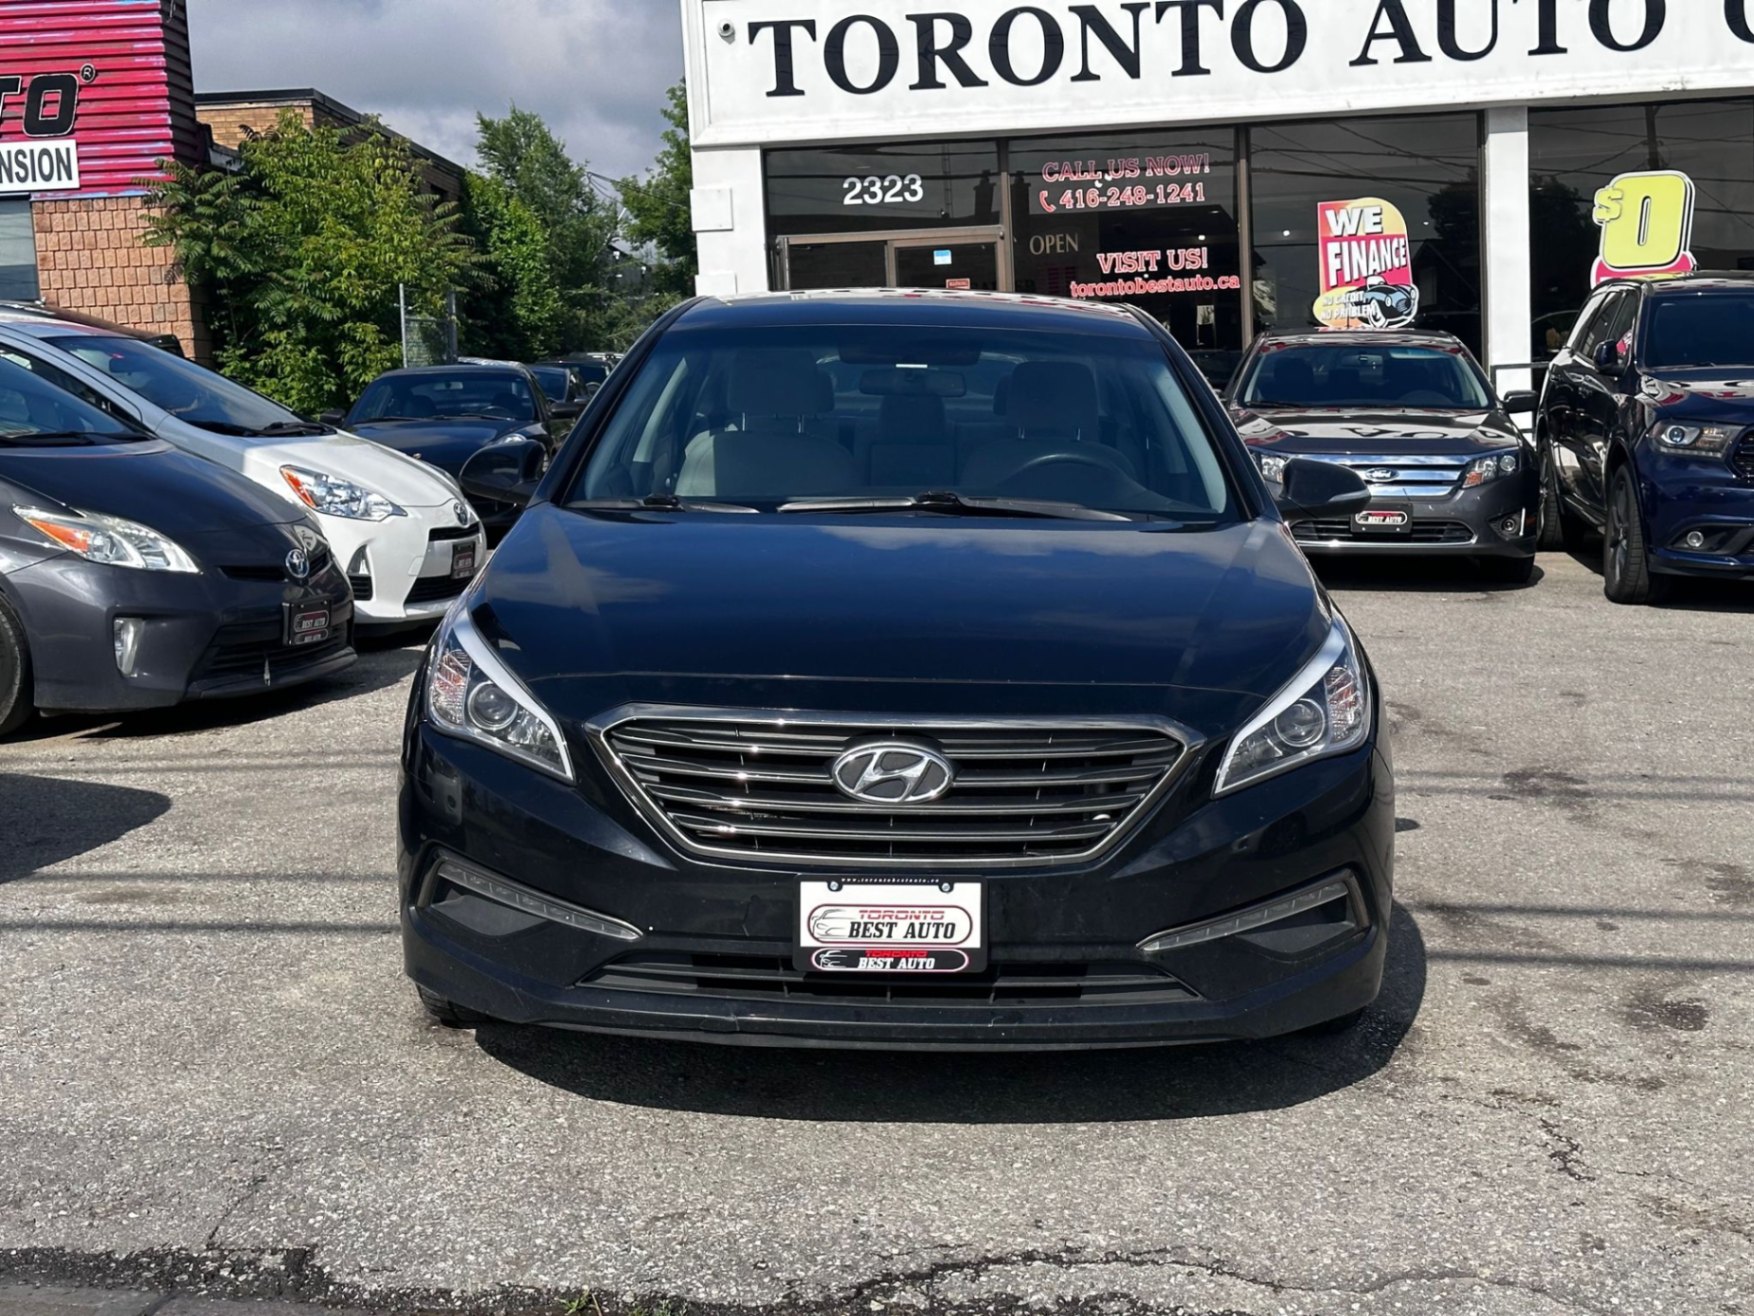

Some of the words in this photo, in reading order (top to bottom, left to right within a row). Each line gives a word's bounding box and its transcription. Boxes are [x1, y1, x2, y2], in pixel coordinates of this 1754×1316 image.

[748, 0, 1307, 97] TORONTO
[1349, 0, 1667, 66] AUTO
[1042, 160, 1102, 182] CALL
[1107, 158, 1140, 179] US
[1145, 153, 1210, 177] NOW!
[842, 173, 924, 205] 2323
[1059, 182, 1206, 209] 416-248-1241
[1325, 205, 1383, 237] WE
[1593, 171, 1691, 270] $0
[1029, 233, 1079, 255] OPEN
[1096, 250, 1161, 274] VISIT
[1166, 247, 1208, 271] US!
[1327, 237, 1407, 288] FINANCE
[1070, 274, 1241, 298] torontobestauto.ca
[858, 909, 945, 921] TORONTO
[848, 921, 898, 939] BEST
[903, 922, 956, 940] AUTO
[857, 957, 895, 970] BEST
[896, 957, 936, 970] AUTO
